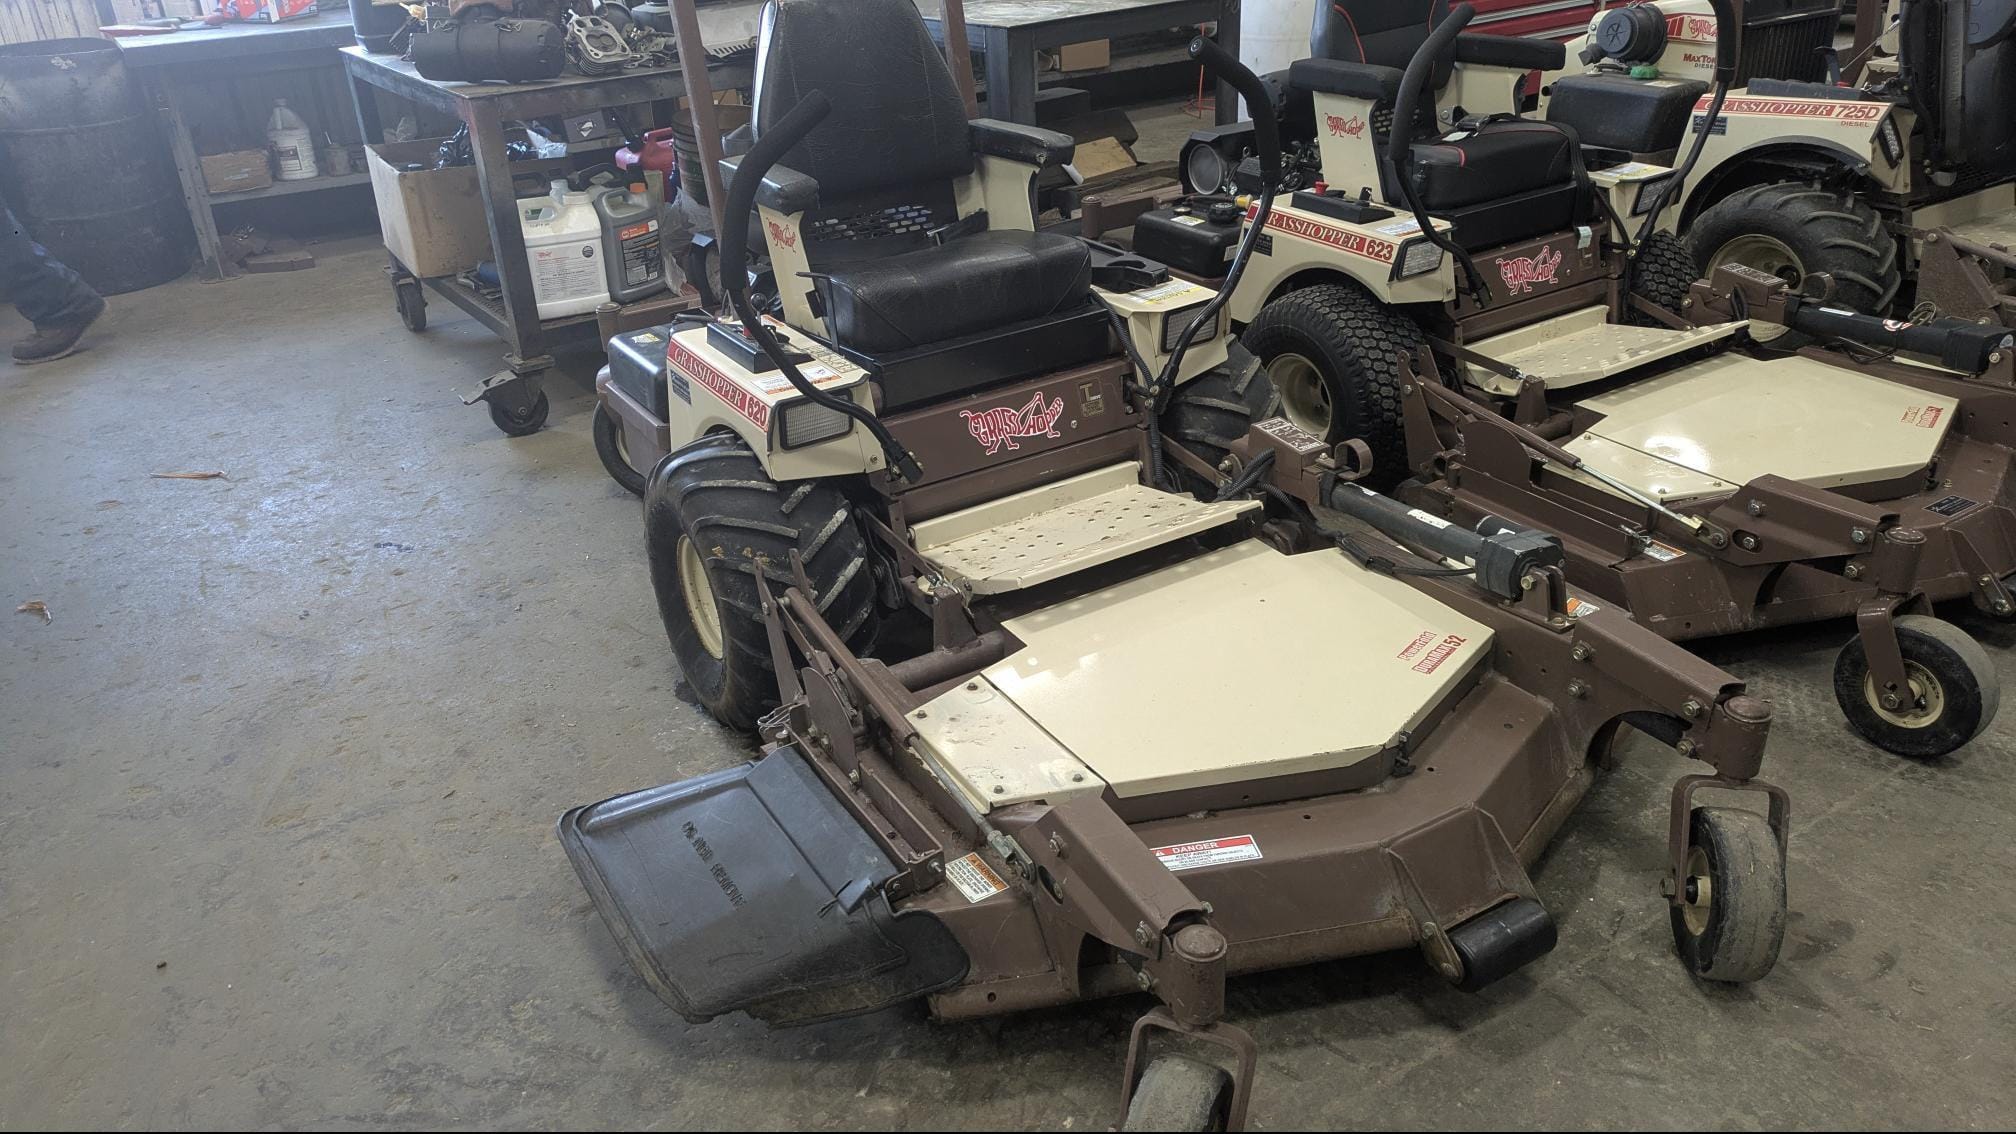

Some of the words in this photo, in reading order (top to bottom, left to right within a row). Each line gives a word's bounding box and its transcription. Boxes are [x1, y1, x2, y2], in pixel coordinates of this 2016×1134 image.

[1835, 104, 1880, 119] 725D
[1266, 212, 1360, 251] RASSHOPPER
[1365, 239, 1393, 261] 623
[674, 347, 743, 407] GRASSHOPPER
[746, 397, 768, 427] 620
[960, 391, 1064, 456] GRASSHOPPER
[1443, 634, 1467, 648] 52
[1172, 841, 1219, 854] DANGER
